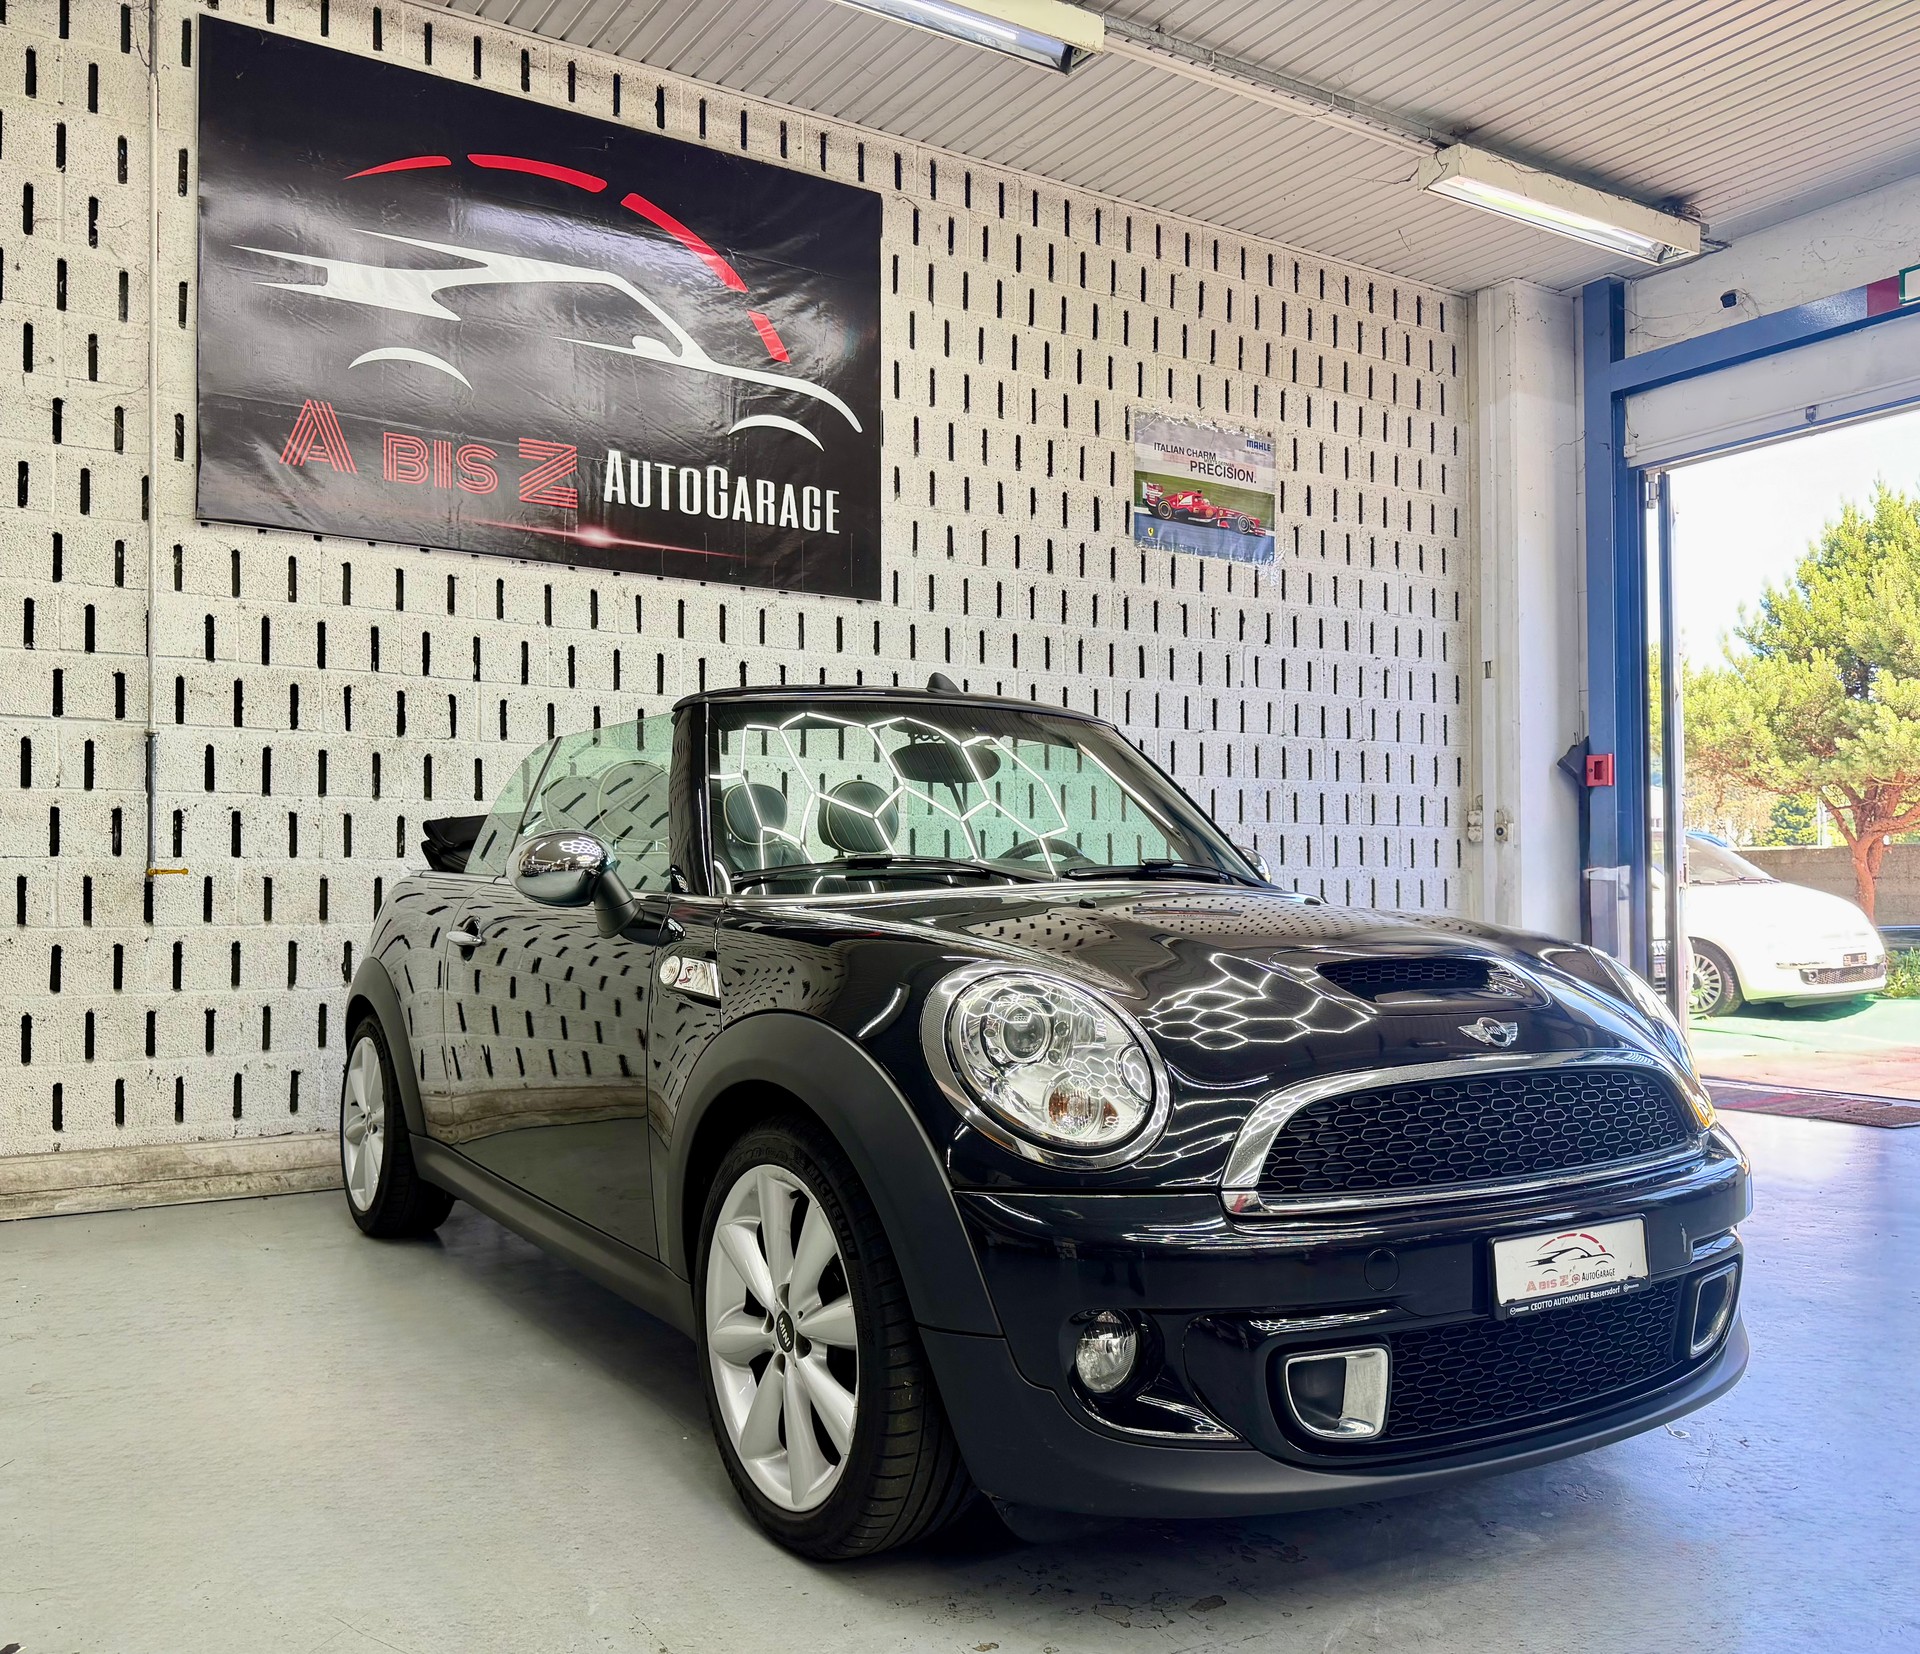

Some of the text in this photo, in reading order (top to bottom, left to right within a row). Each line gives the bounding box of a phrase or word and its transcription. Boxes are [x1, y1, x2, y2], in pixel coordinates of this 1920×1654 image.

[278, 398, 358, 475] A
[382, 430, 499, 496] BIS
[518, 436, 579, 510] Z
[1154, 442, 1217, 461] ITALIAN CHARM
[1246, 439, 1272, 452] MAHLE
[1190, 460, 1257, 484] PRECISION.
[806, 1163, 857, 1255] MICHELIN
[1526, 1280, 1537, 1293] A
[1539, 1281, 1557, 1291] BIS
[1559, 1274, 1569, 1288] Z
[1530, 1299, 1553, 1311] CEOTTO
[1553, 1292, 1590, 1307] AUTOMOBILE
[1590, 1286, 1621, 1299] Bassersdorf
[778, 1317, 792, 1347] MINI
